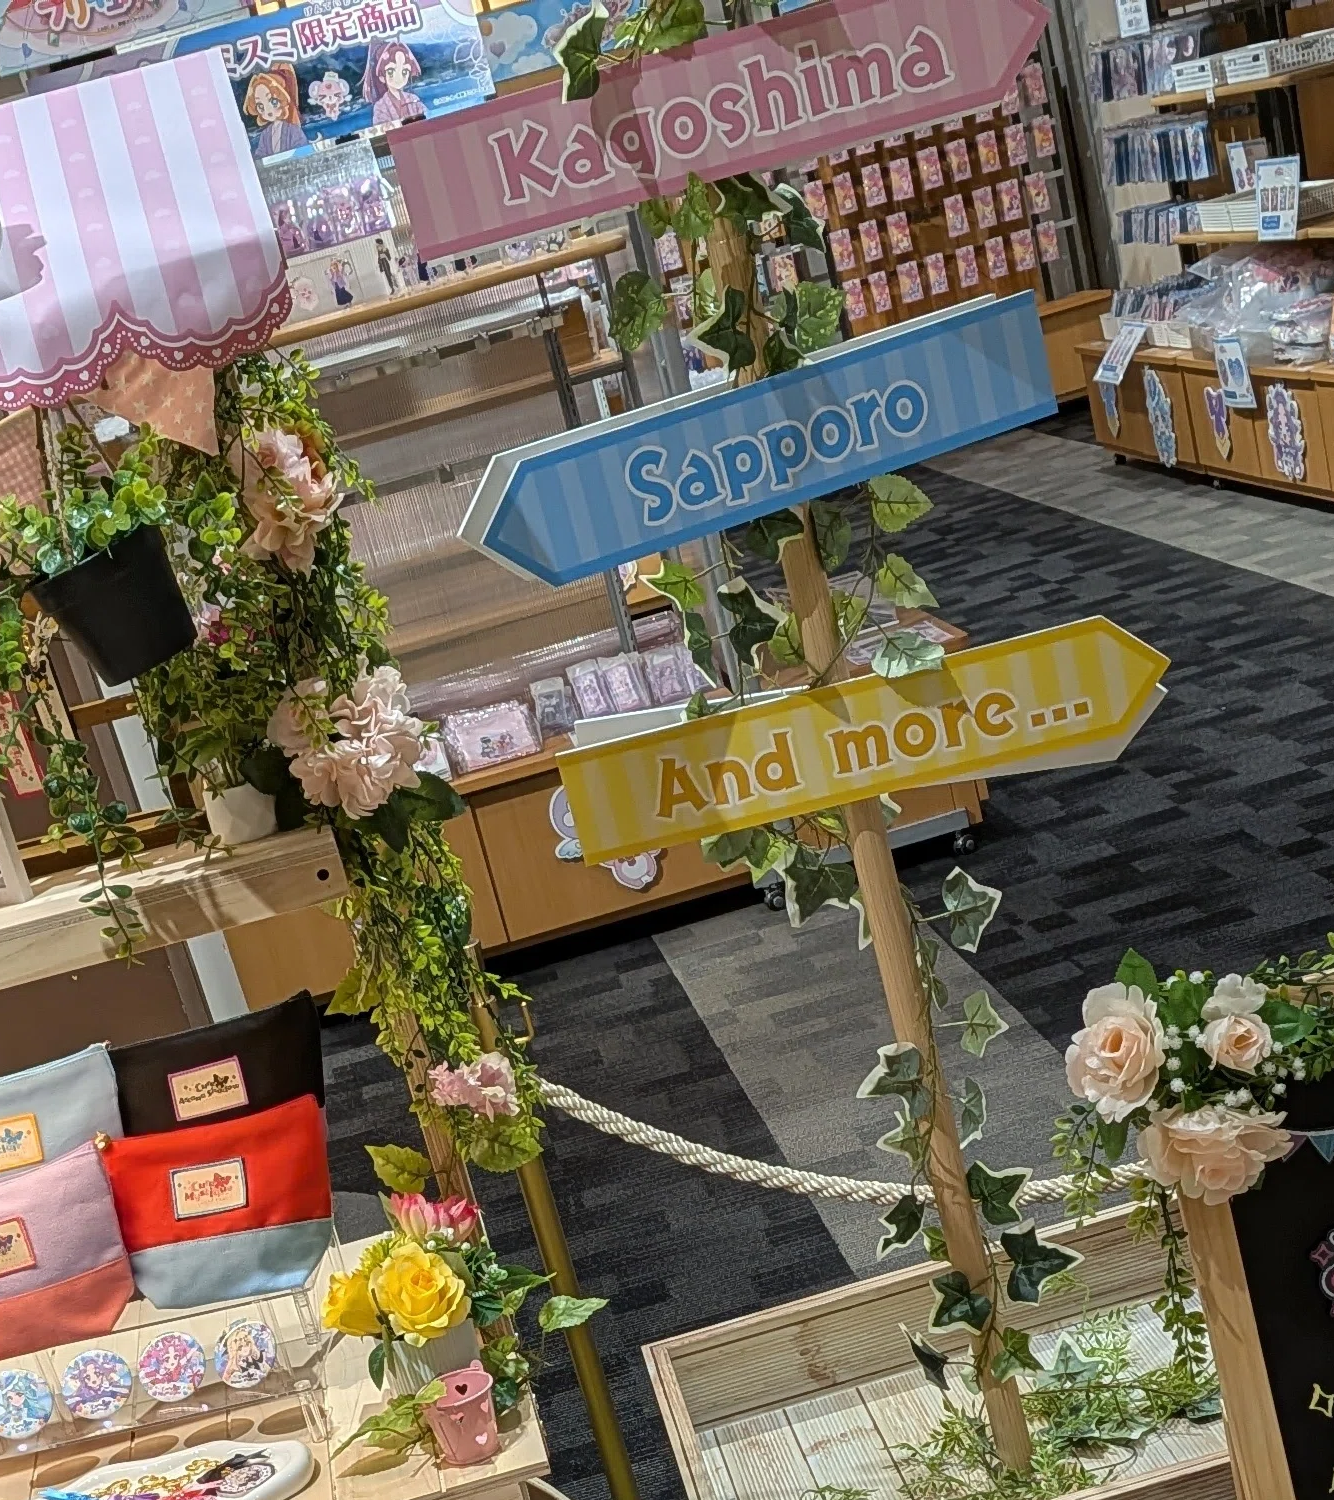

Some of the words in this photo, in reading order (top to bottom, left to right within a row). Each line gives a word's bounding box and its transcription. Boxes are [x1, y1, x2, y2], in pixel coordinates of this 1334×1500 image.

[489, 26, 953, 205] Kagoshima
[626, 380, 927, 526] Sapporo
[655, 731, 799, 819] And
